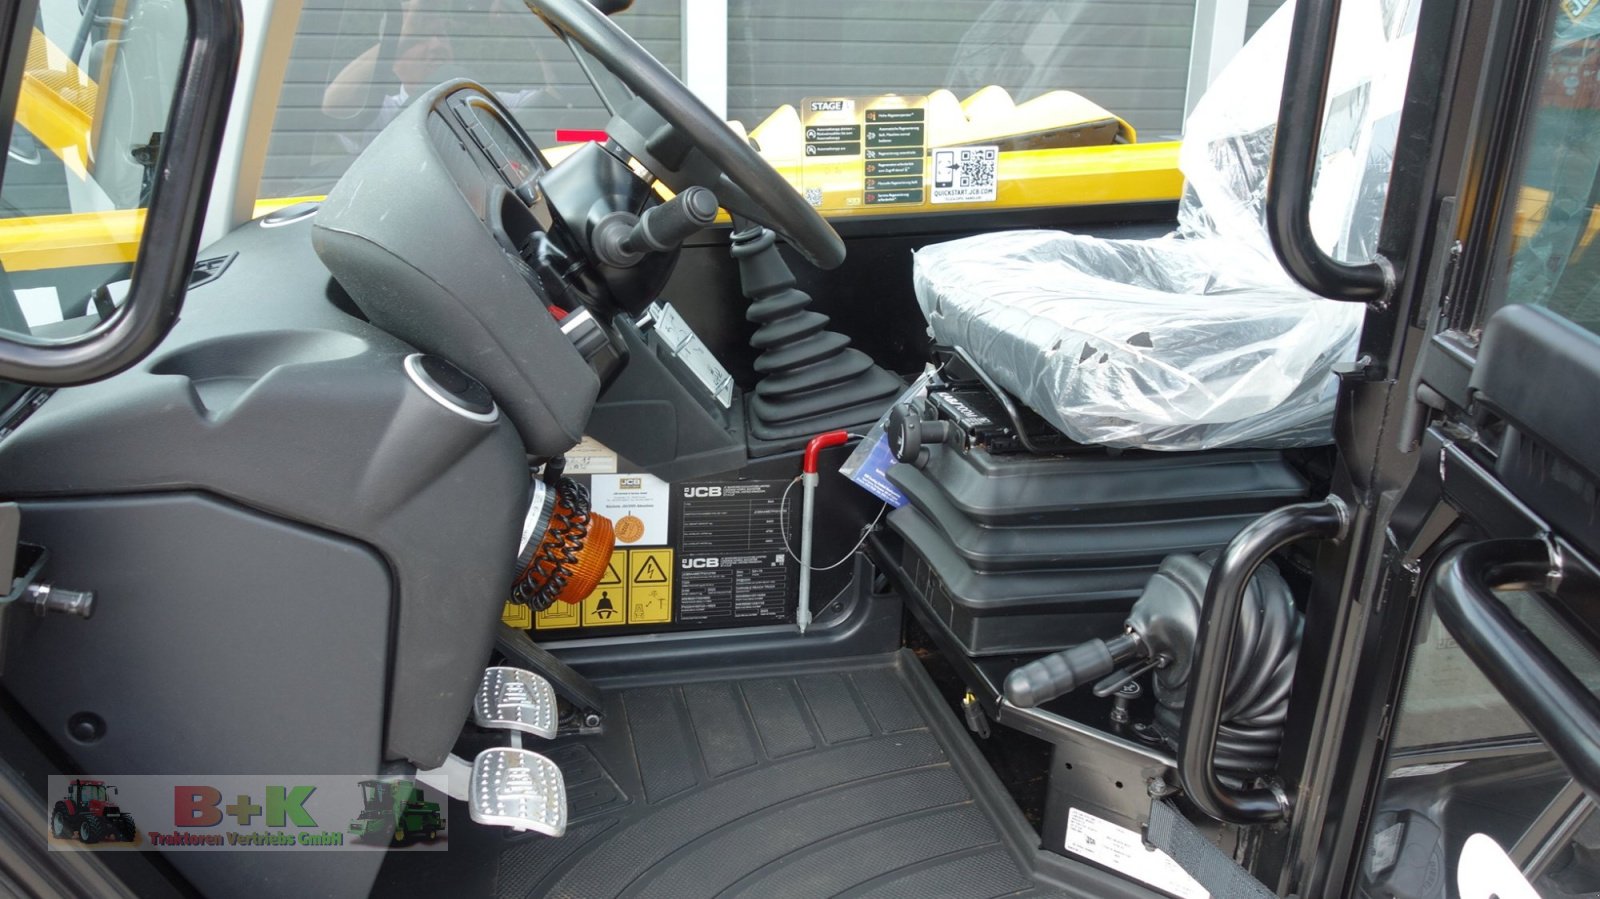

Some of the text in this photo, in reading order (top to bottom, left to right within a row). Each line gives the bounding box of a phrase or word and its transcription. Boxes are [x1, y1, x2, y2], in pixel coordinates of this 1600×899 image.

[811, 101, 842, 111] STAGE
[683, 486, 722, 498] JCB
[681, 557, 719, 569] JCB
